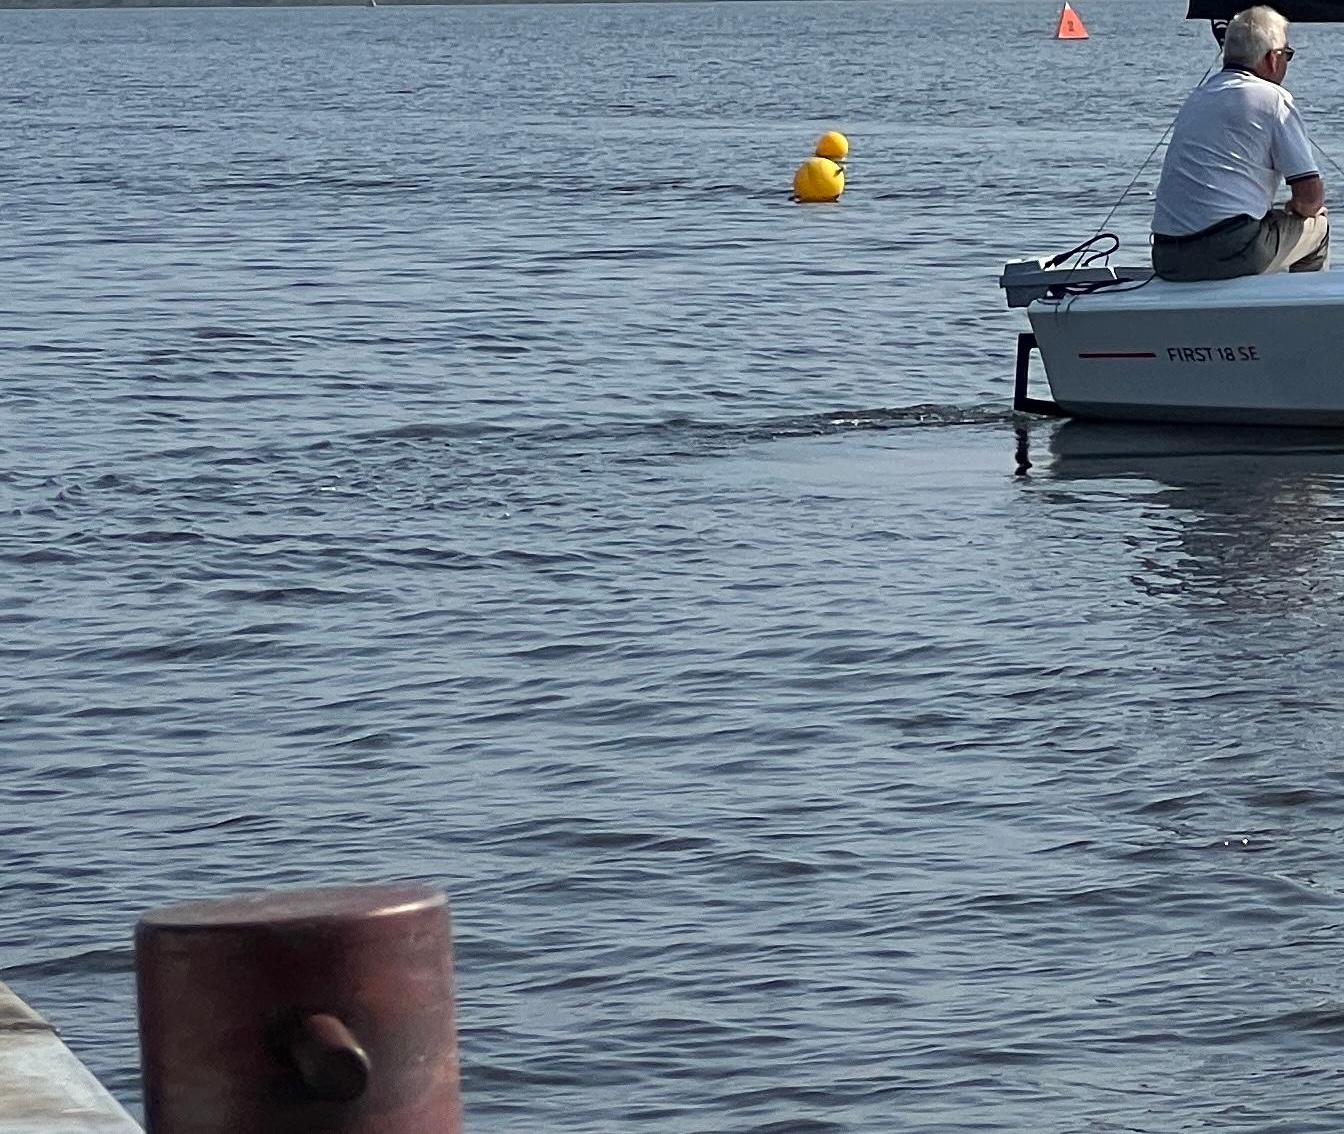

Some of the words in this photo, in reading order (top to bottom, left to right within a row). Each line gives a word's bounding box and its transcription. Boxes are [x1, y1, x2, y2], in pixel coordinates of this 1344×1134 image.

[1167, 347, 1214, 363] FIRST
[1216, 347, 1235, 362] 18
[1240, 346, 1261, 362] SE
